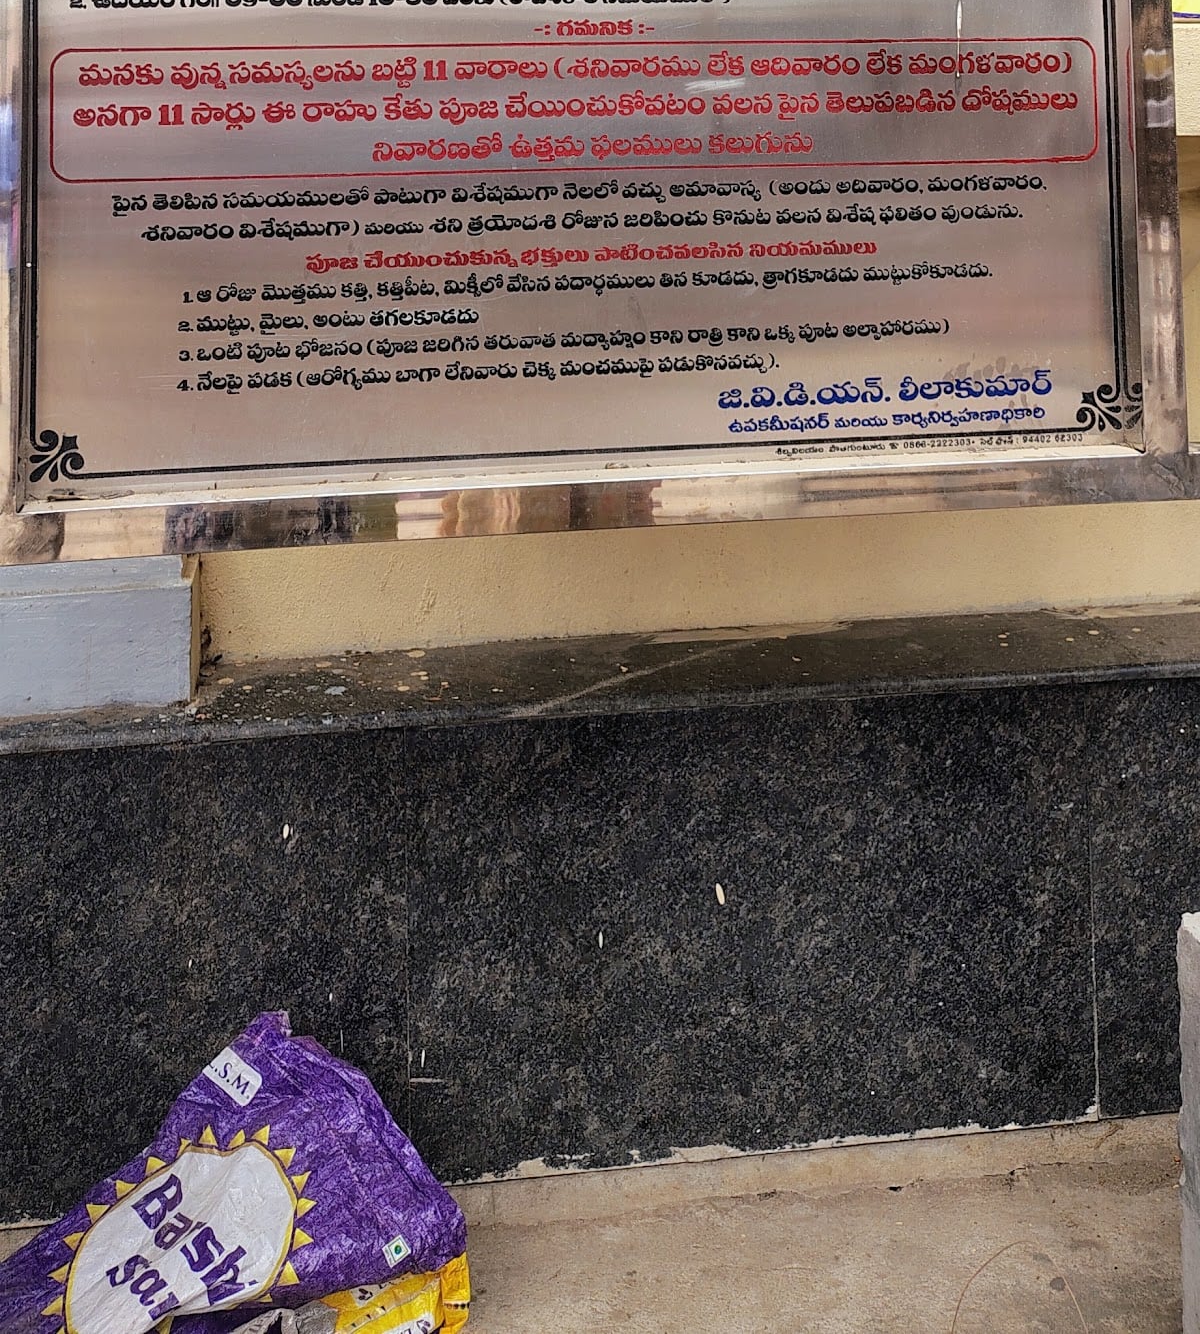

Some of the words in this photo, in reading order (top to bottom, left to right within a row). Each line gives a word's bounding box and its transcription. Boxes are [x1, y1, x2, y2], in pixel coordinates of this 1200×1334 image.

[556, 18, 634, 37] గమనిక
[78, 62, 165, 87] మనకు
[371, 56, 418, 89] బట్టి
[423, 59, 449, 82] 11
[454, 59, 548, 81] వారాలు
[707, 50, 745, 77] లేక
[750, 54, 861, 77] ఆదివారం
[866, 48, 903, 76] లేక
[72, 103, 152, 127] అనగా
[157, 103, 185, 126] 11
[190, 101, 256, 131] సార్లు
[261, 100, 297, 124] ఈ
[302, 99, 377, 123] రాహు
[382, 92, 433, 121] కేతు
[438, 97, 499, 126] పూజ
[712, 93, 773, 115] వలన
[776, 92, 820, 121] పైన
[825, 88, 956, 114] తెలుపబడిన
[961, 85, 1079, 116] దోషములు
[372, 131, 503, 162] నివారణతో
[508, 133, 585, 163] ఉత్తమ
[590, 133, 703, 161] ఫలములు
[708, 131, 813, 154] కలుగును
[305, 253, 359, 275] పూజ
[748, 239, 878, 258] నియమములు
[177, 320, 194, 333] 2.
[312, 310, 366, 328] అంటు
[369, 308, 480, 327] తగలకూడదు
[176, 379, 191, 392] 4.
[196, 370, 244, 395] నేలపై
[247, 371, 293, 389] పడక
[395, 367, 441, 383] బాగా
[444, 360, 518, 381] లేనివారు
[521, 361, 557, 382] చెక్క
[559, 357, 655, 379] మంచముపై
[898, 369, 1053, 402] లీలాకుమార్
[834, 415, 889, 429] మరియు
